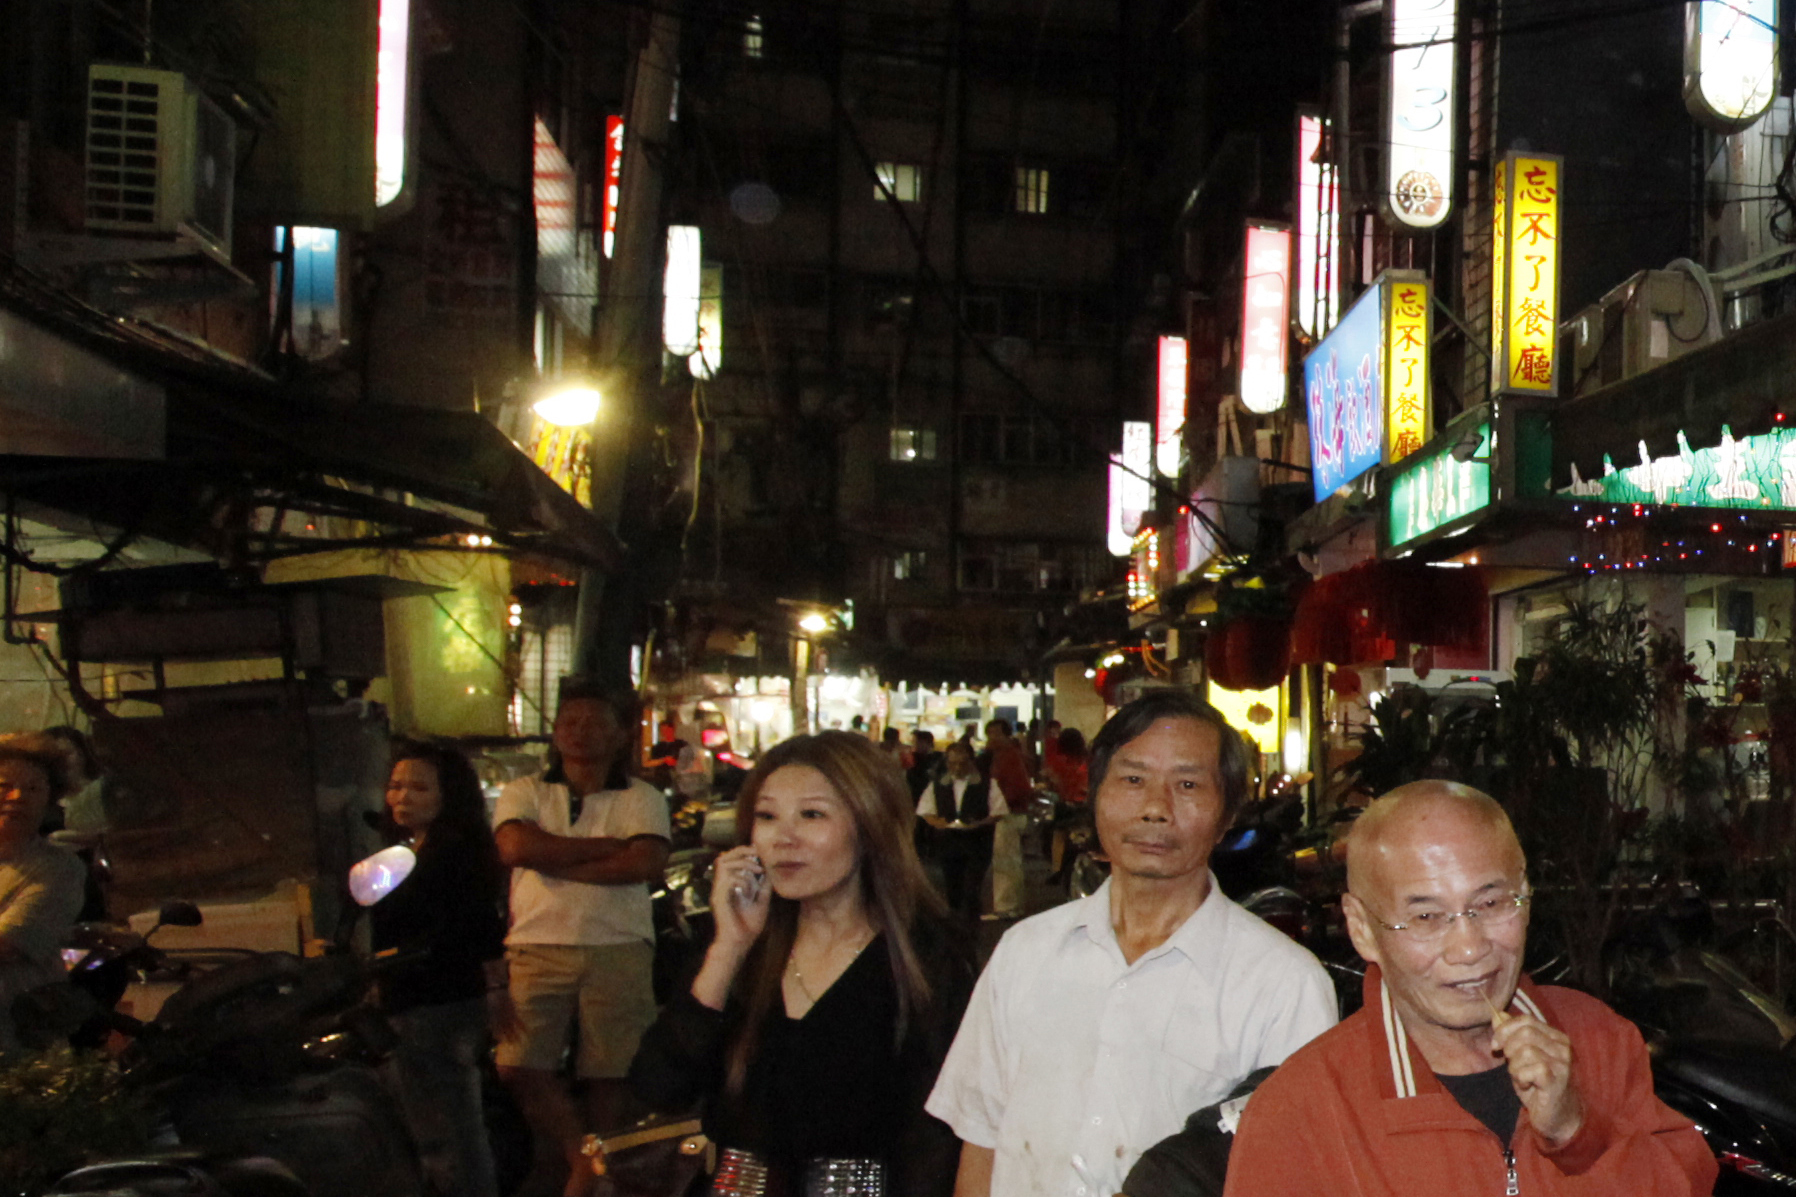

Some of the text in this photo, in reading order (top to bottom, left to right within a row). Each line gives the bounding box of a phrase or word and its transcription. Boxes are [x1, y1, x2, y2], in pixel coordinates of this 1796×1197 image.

[1388, 285, 1427, 464] 忘不了餐廳
[1513, 164, 1554, 386] 忘不了餐廳
